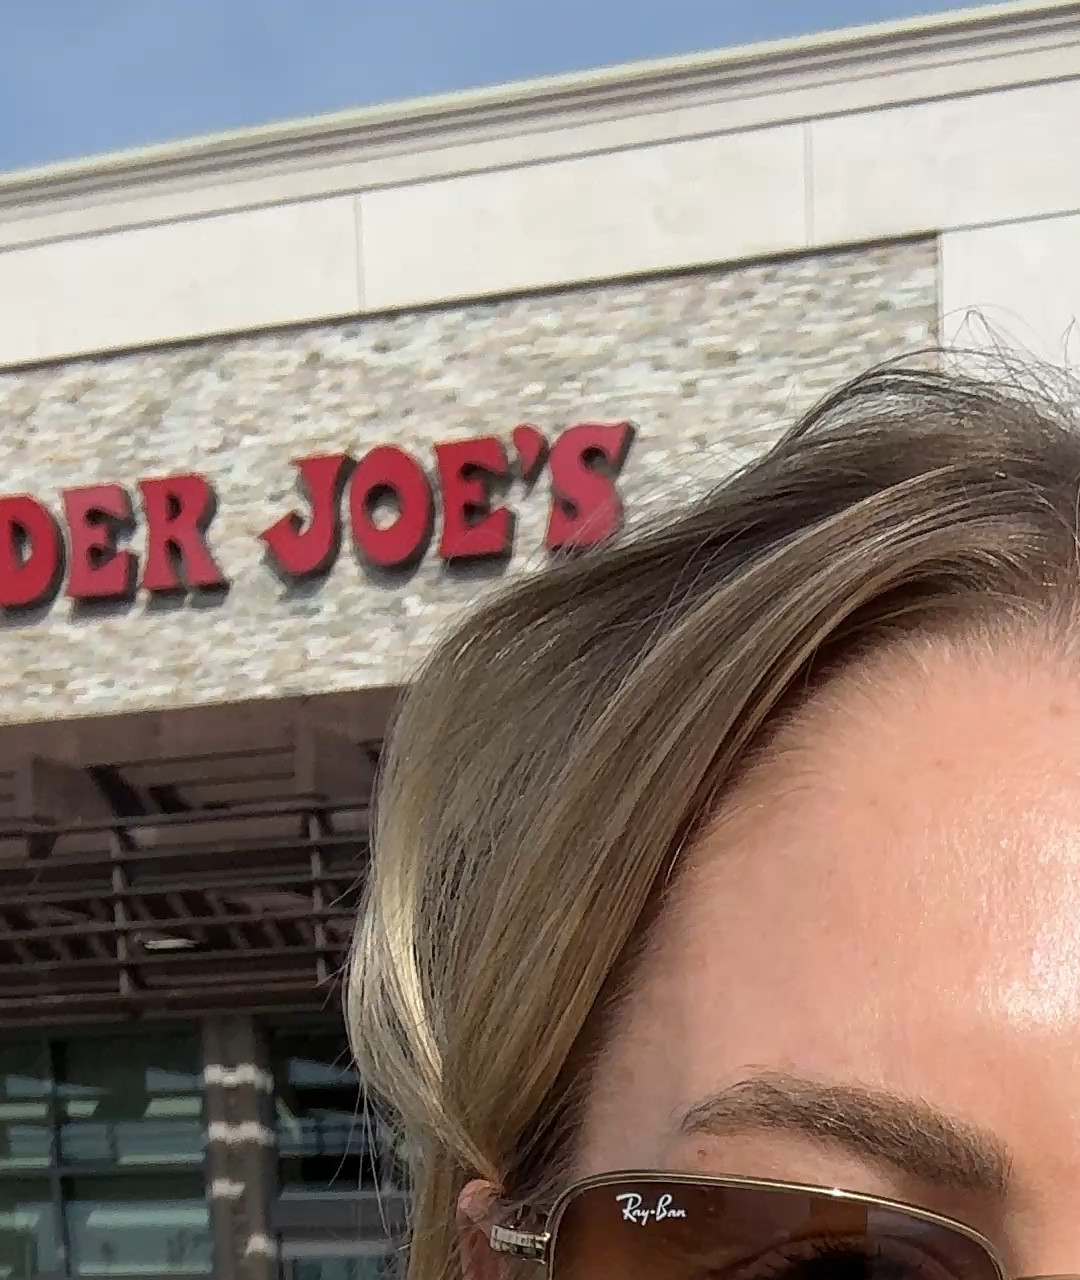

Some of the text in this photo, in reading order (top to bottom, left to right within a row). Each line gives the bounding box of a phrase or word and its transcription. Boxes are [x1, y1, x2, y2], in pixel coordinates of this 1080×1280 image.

[0, 421, 635, 609] DER JOE'S
[616, 1193, 686, 1226] Ray-Ban
